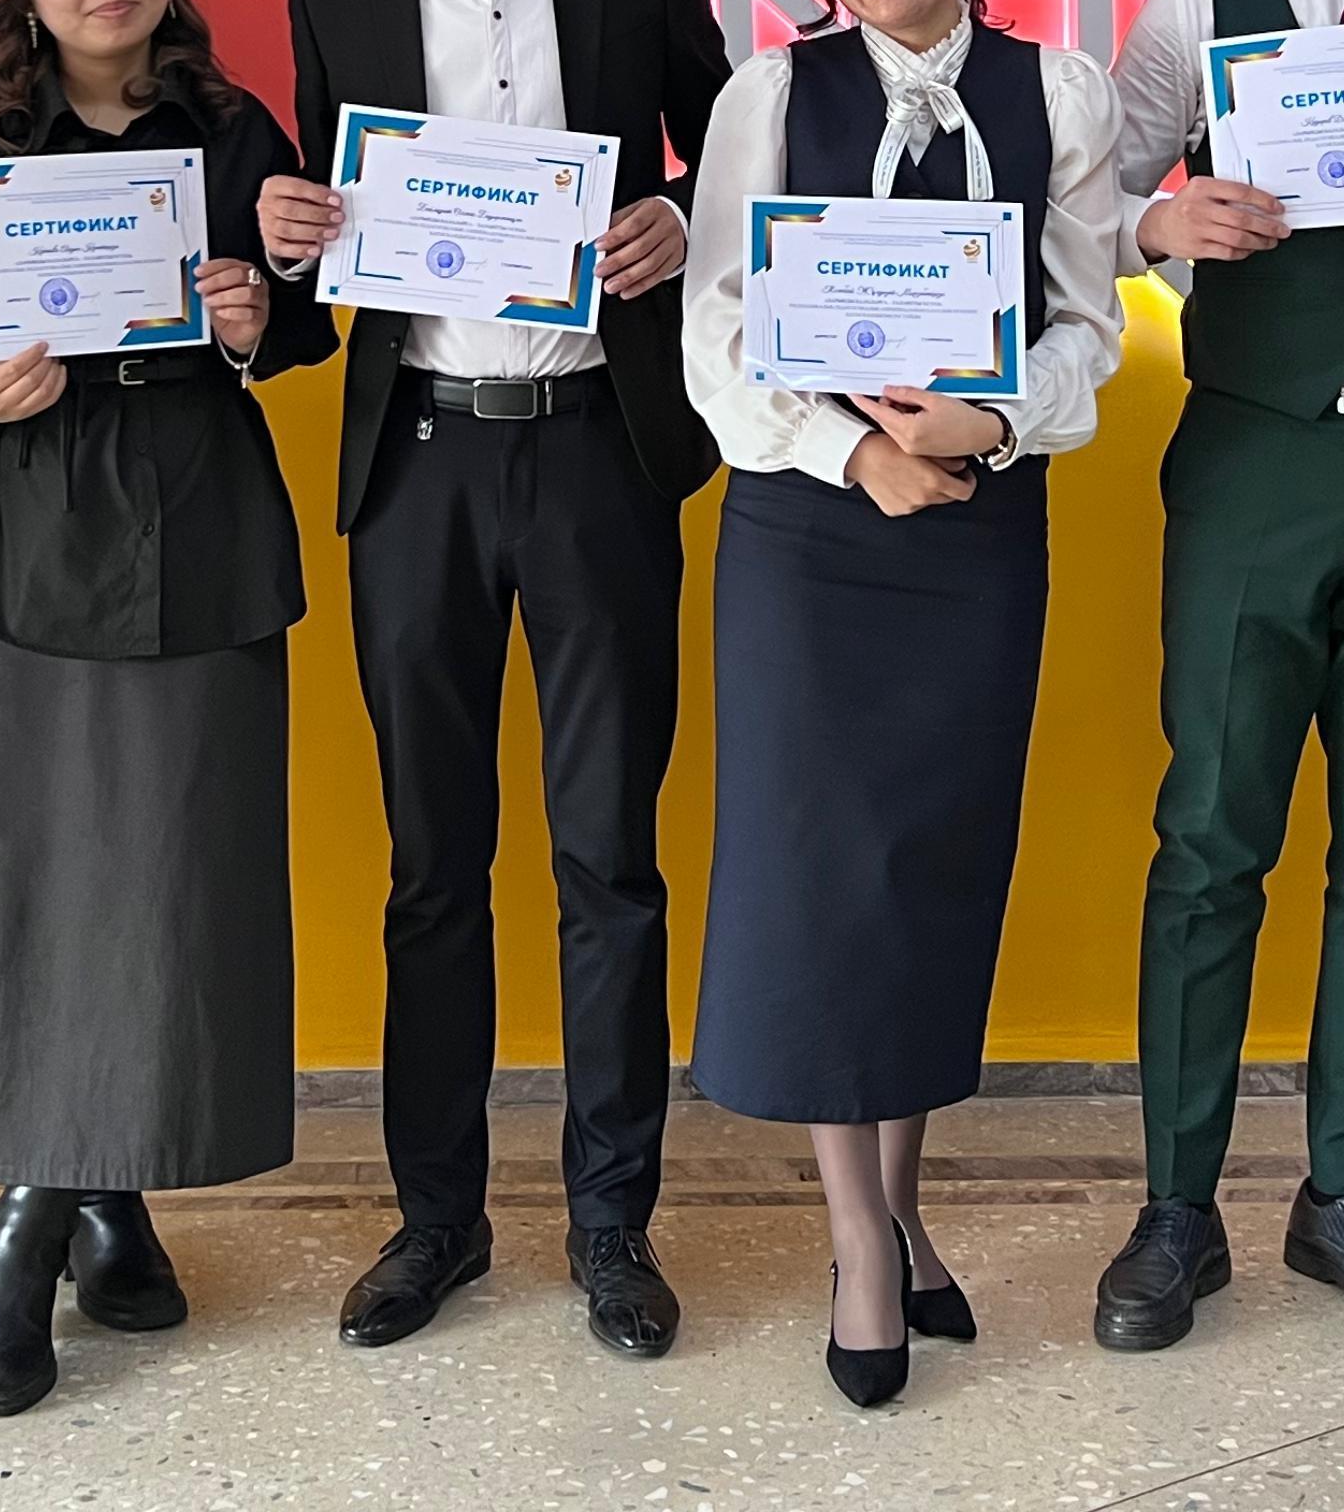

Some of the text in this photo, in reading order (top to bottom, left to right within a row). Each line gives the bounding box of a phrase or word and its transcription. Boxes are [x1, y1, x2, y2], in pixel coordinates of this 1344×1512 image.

[406, 179, 539, 205] СЕРТИФИКАТ
[5, 215, 137, 238] СЕРТИФИКАТ
[816, 260, 950, 279] СЕРТИФИКАТ
